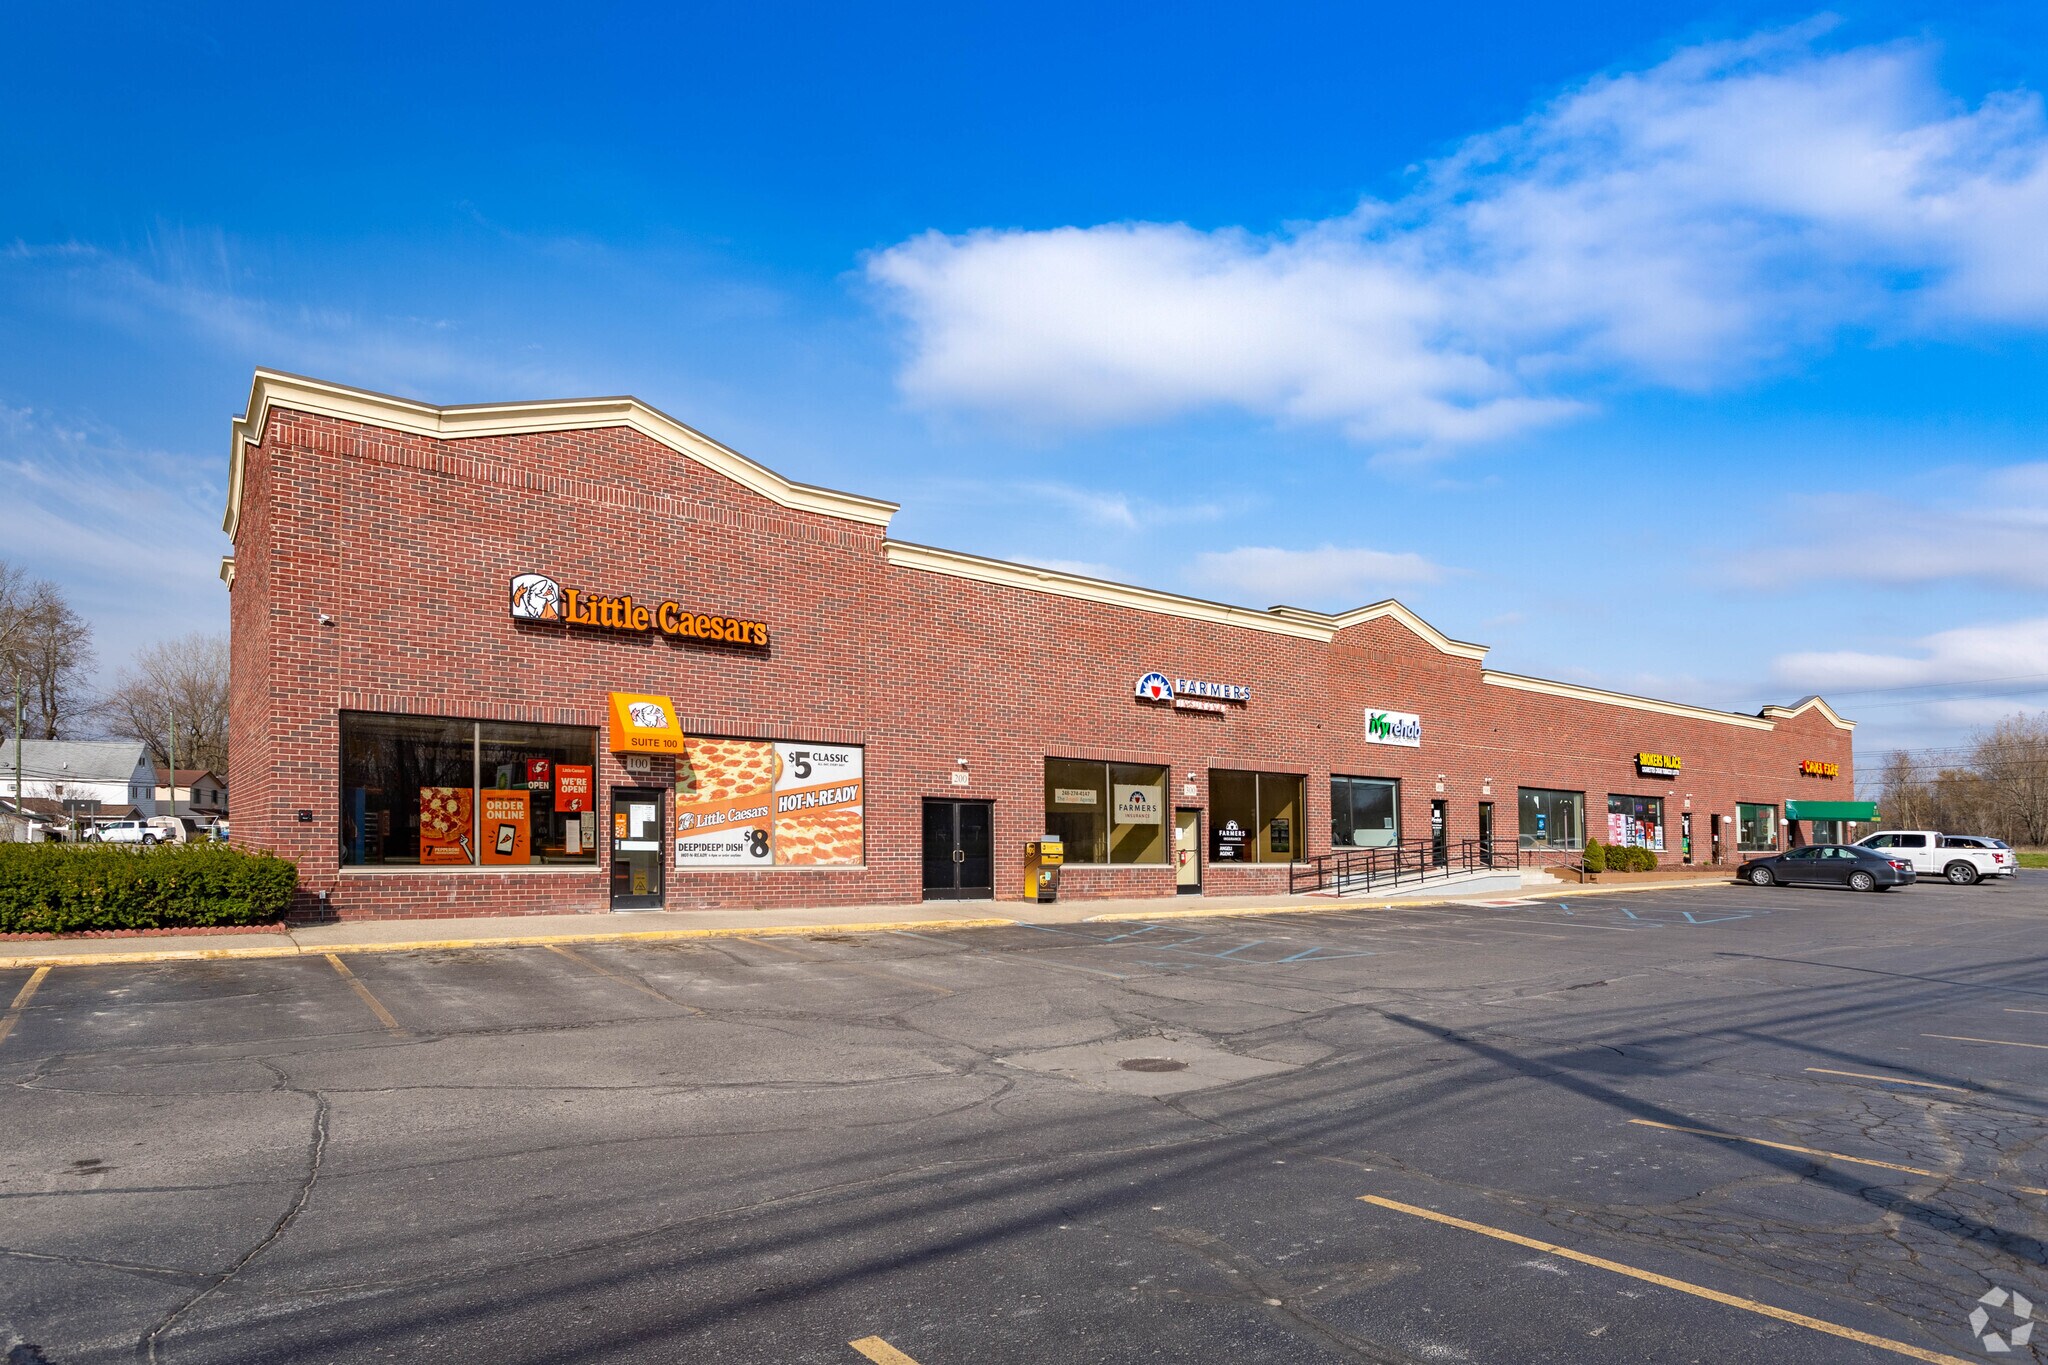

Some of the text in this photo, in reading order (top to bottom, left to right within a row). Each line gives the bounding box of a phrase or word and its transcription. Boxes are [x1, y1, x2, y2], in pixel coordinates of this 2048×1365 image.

[563, 588, 769, 646] Little Caesars
[1178, 679, 1251, 700] FARMERS
[631, 737, 678, 748] SUITE 100
[812, 752, 849, 763] CLASSIC
[629, 758, 648, 769] 100
[561, 778, 588, 786] WE'RE
[953, 774, 968, 783] 200
[528, 782, 550, 790] OPEN
[561, 786, 587, 794] OPEN!
[777, 784, 860, 813] HOT-N-READY
[486, 800, 524, 810] ORDER
[1118, 804, 1157, 812] FARMERS
[486, 810, 524, 820] ONLINE
[695, 806, 769, 828] Little Caesars
[726, 843, 744, 852] DISH
